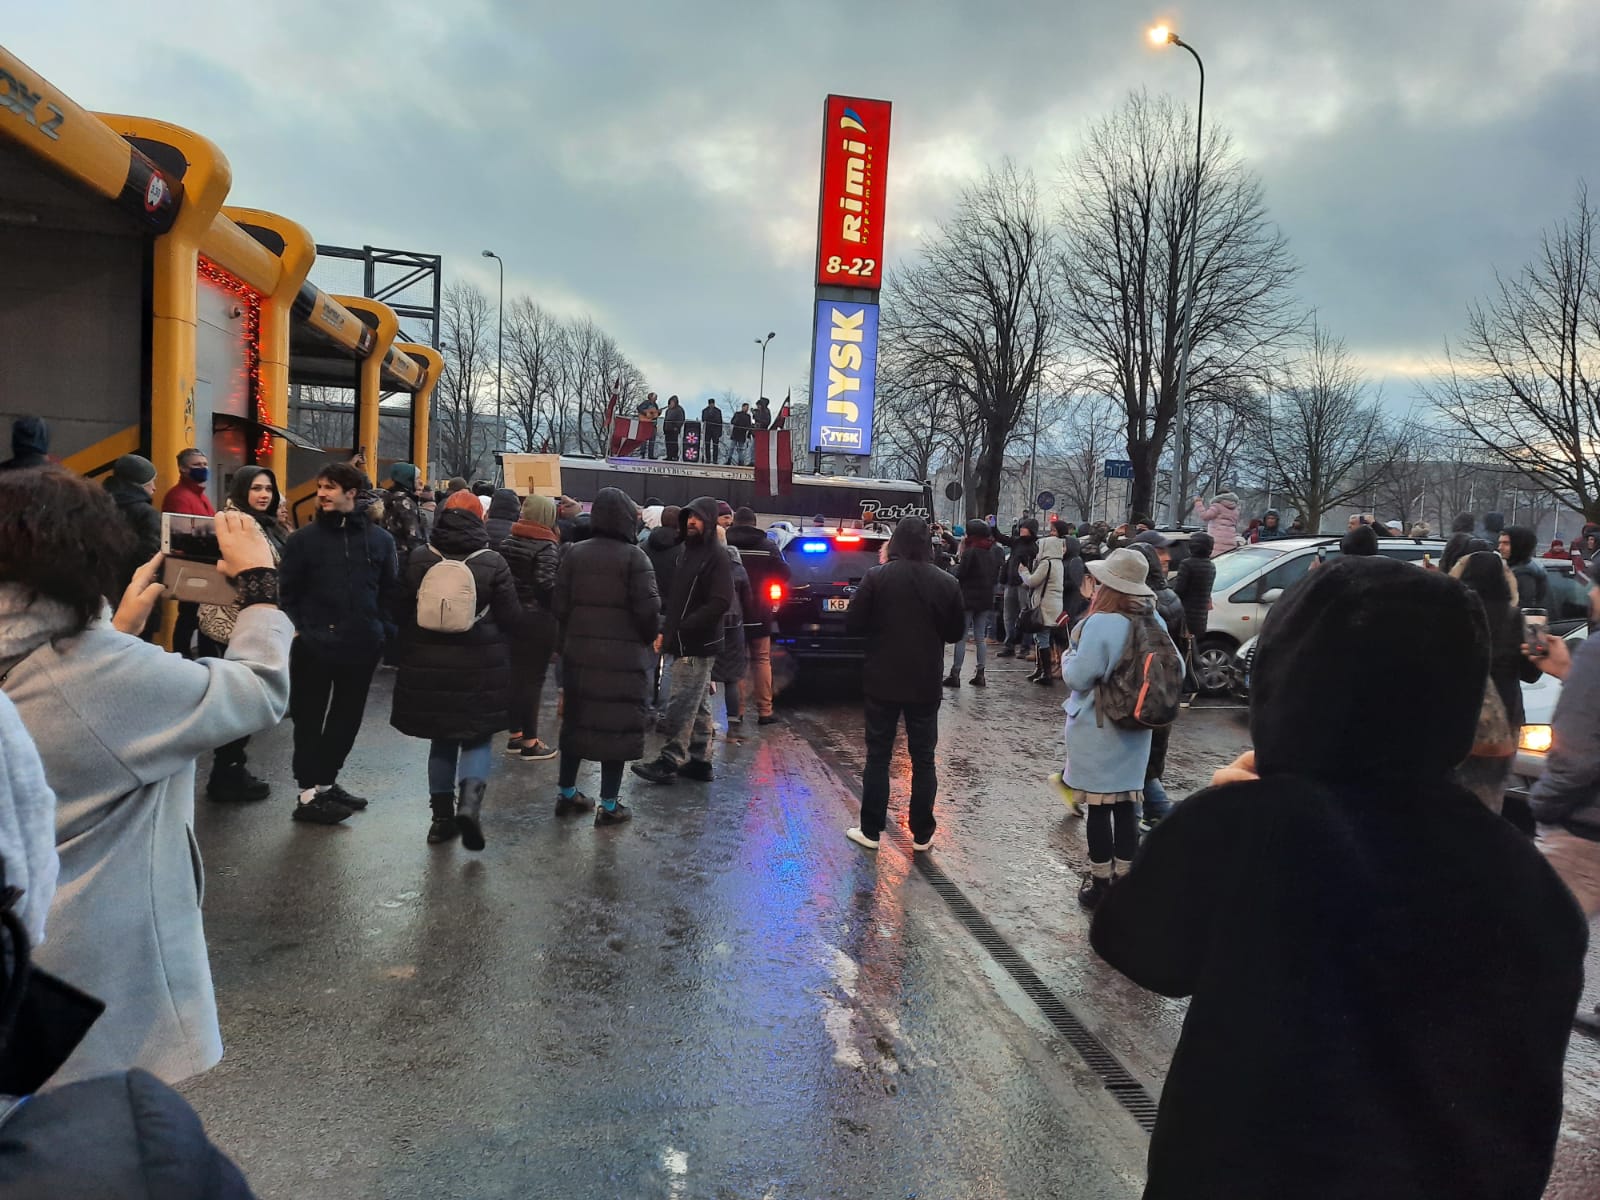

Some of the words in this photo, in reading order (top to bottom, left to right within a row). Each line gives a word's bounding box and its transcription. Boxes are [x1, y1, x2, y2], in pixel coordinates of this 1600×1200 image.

[839, 138, 866, 243] Rimi
[826, 255, 875, 276] 8-22
[826, 307, 864, 423] JYSK
[829, 431, 859, 443] JYSK
